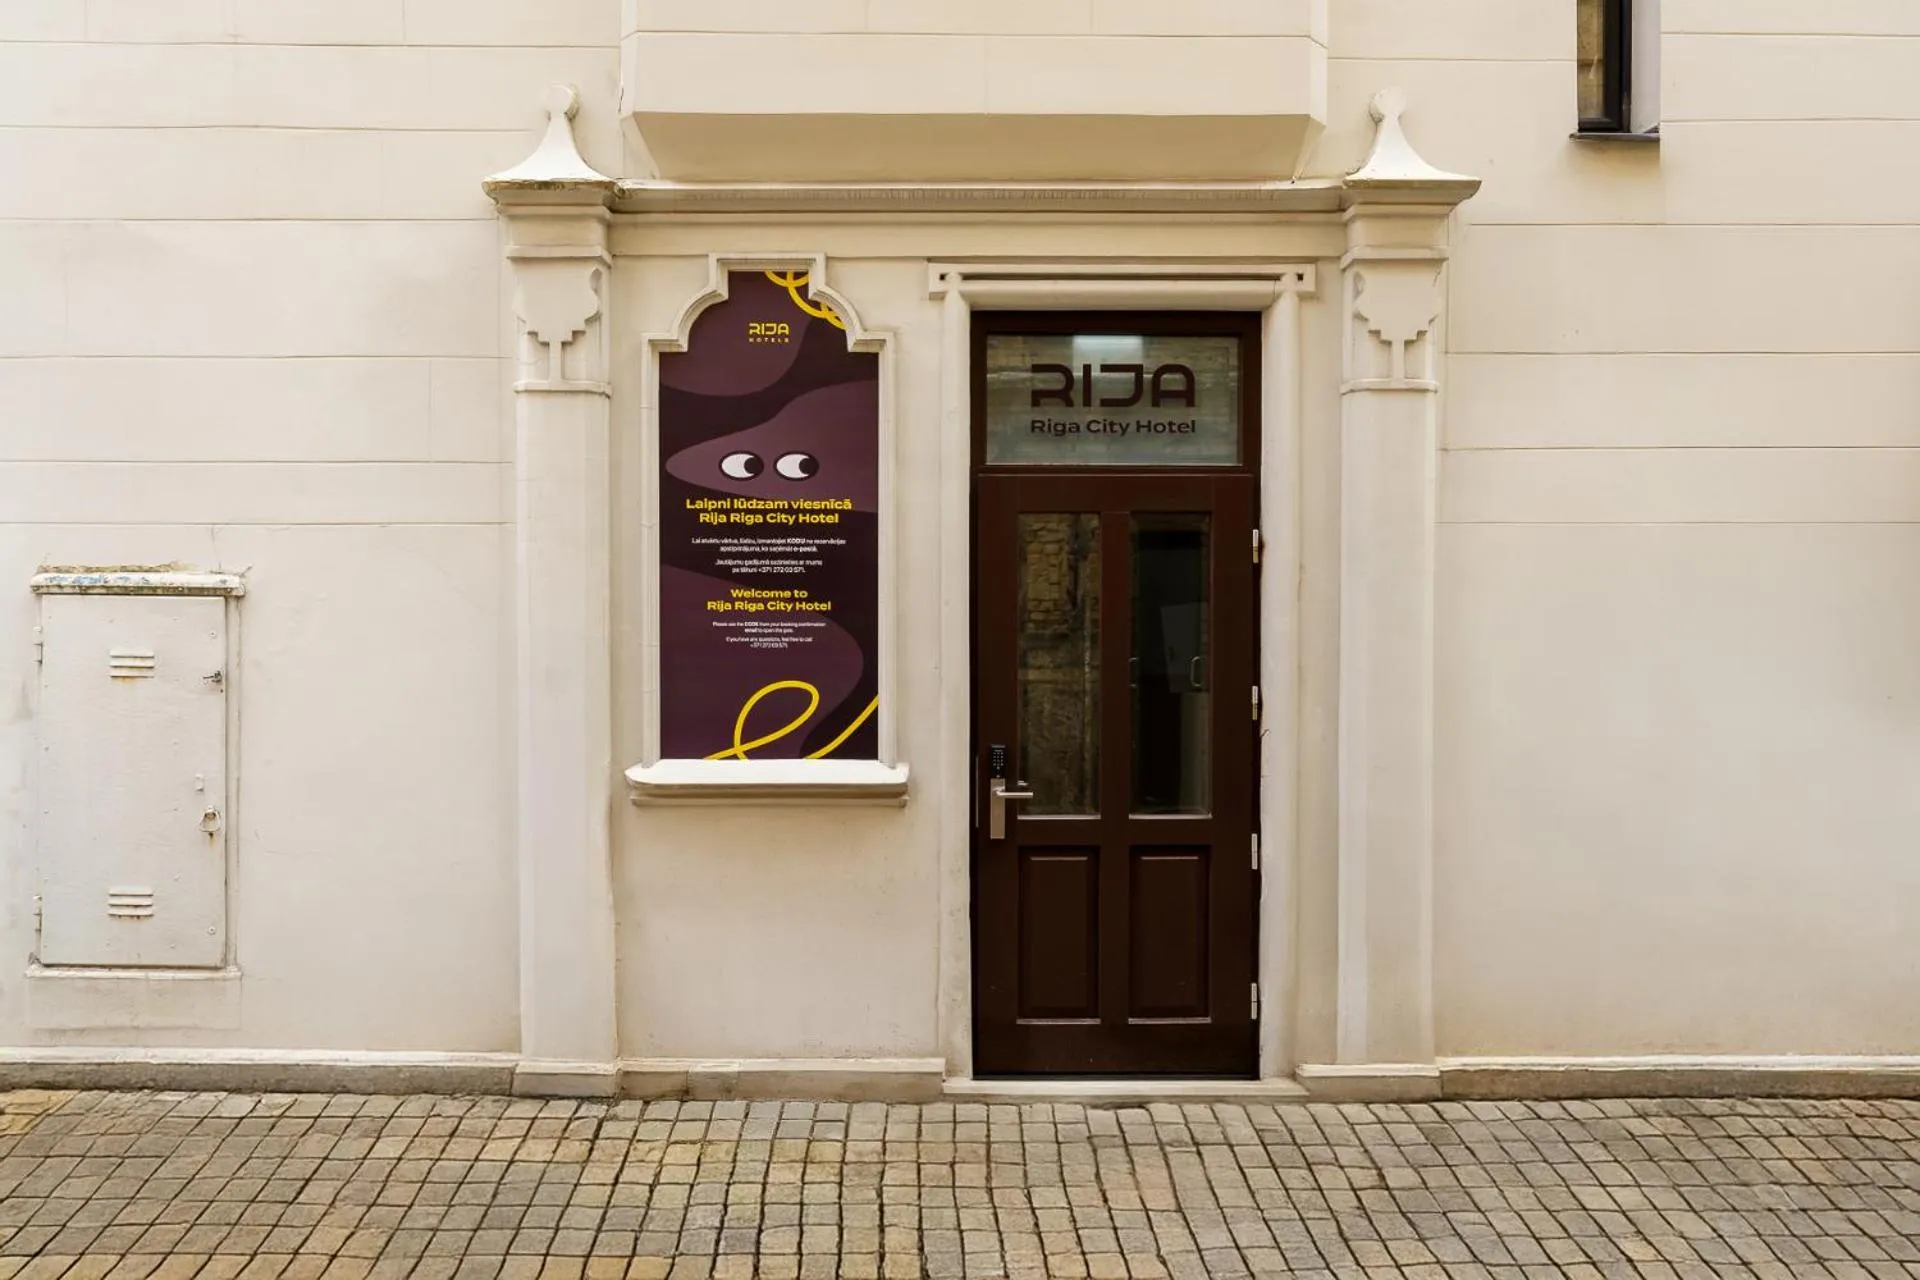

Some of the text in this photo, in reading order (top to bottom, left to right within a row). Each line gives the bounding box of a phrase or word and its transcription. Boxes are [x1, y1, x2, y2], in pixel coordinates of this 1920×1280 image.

[748, 323, 790, 335] RIJA
[1031, 364, 1196, 407] RIJA
[1031, 419, 1196, 436] Riga City Hotel
[686, 498, 852, 511] Laipni lūdzam viesnīcā
[699, 512, 839, 525] Rija Riga City Hotel
[730, 588, 808, 598] Welcome to
[707, 600, 831, 612] Rija Riga City Hotel
